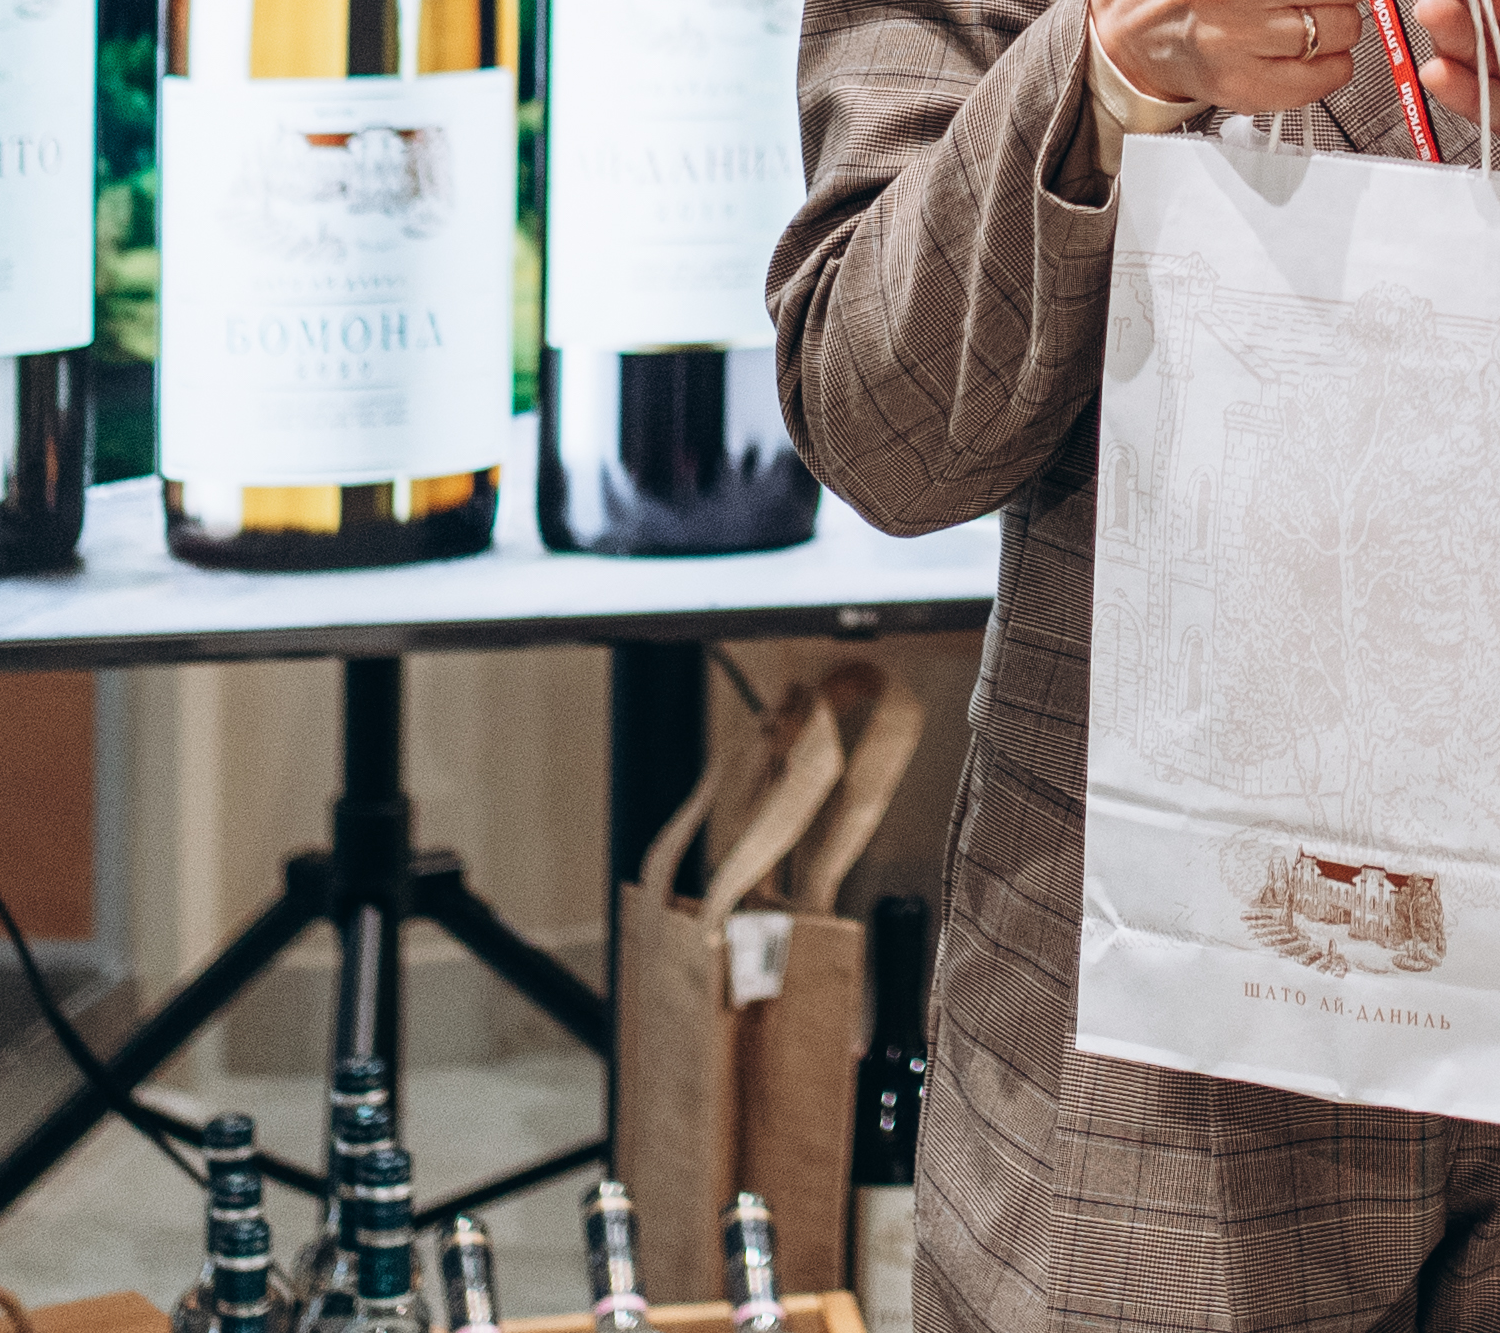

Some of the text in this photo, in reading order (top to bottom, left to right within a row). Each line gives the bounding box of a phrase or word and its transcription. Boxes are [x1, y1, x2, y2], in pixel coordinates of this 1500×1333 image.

[1400, 82, 1427, 145] ЛУКОЙЛ
[225, 308, 445, 354] БОМОНД
[1244, 982, 1451, 1030] ШАТО АЙ-ДАНИЛЬ
